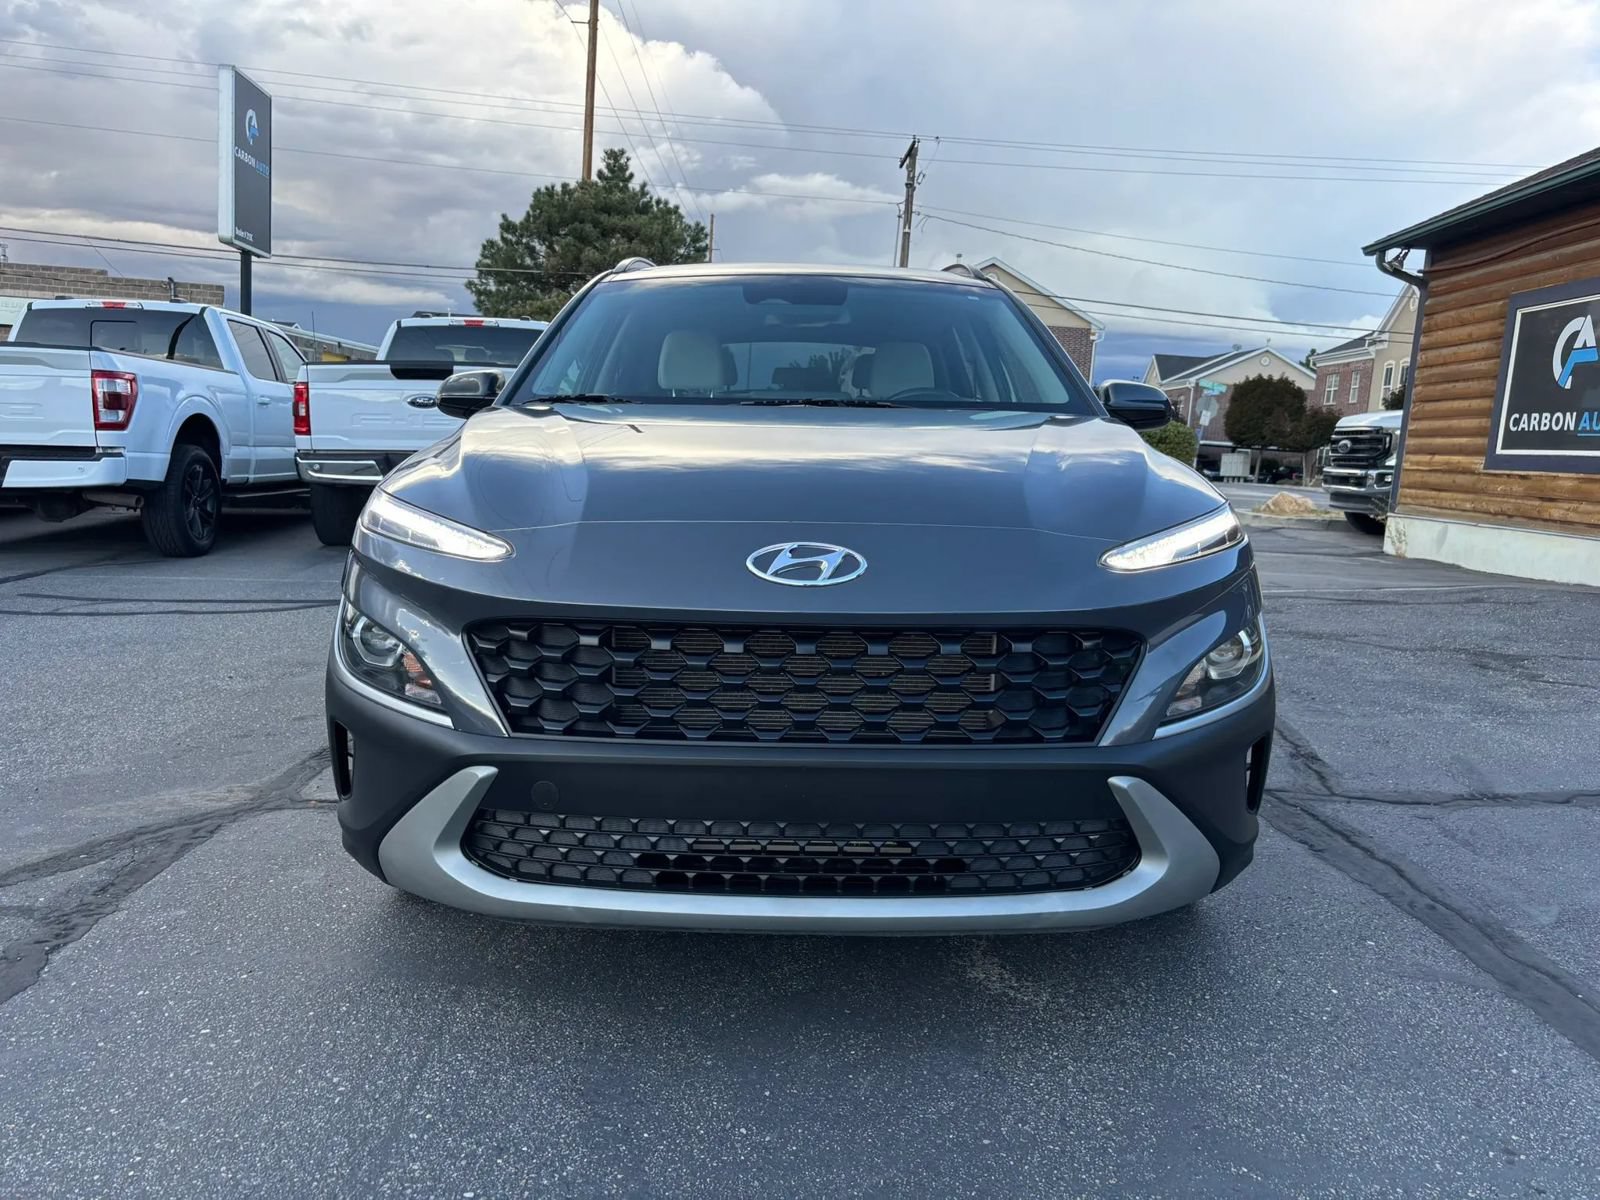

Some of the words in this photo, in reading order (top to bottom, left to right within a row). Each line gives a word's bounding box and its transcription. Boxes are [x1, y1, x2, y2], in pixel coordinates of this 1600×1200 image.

[234, 146, 256, 168] CARBON
[256, 160, 270, 177] AUTO
[1509, 412, 1577, 432] CARBON
